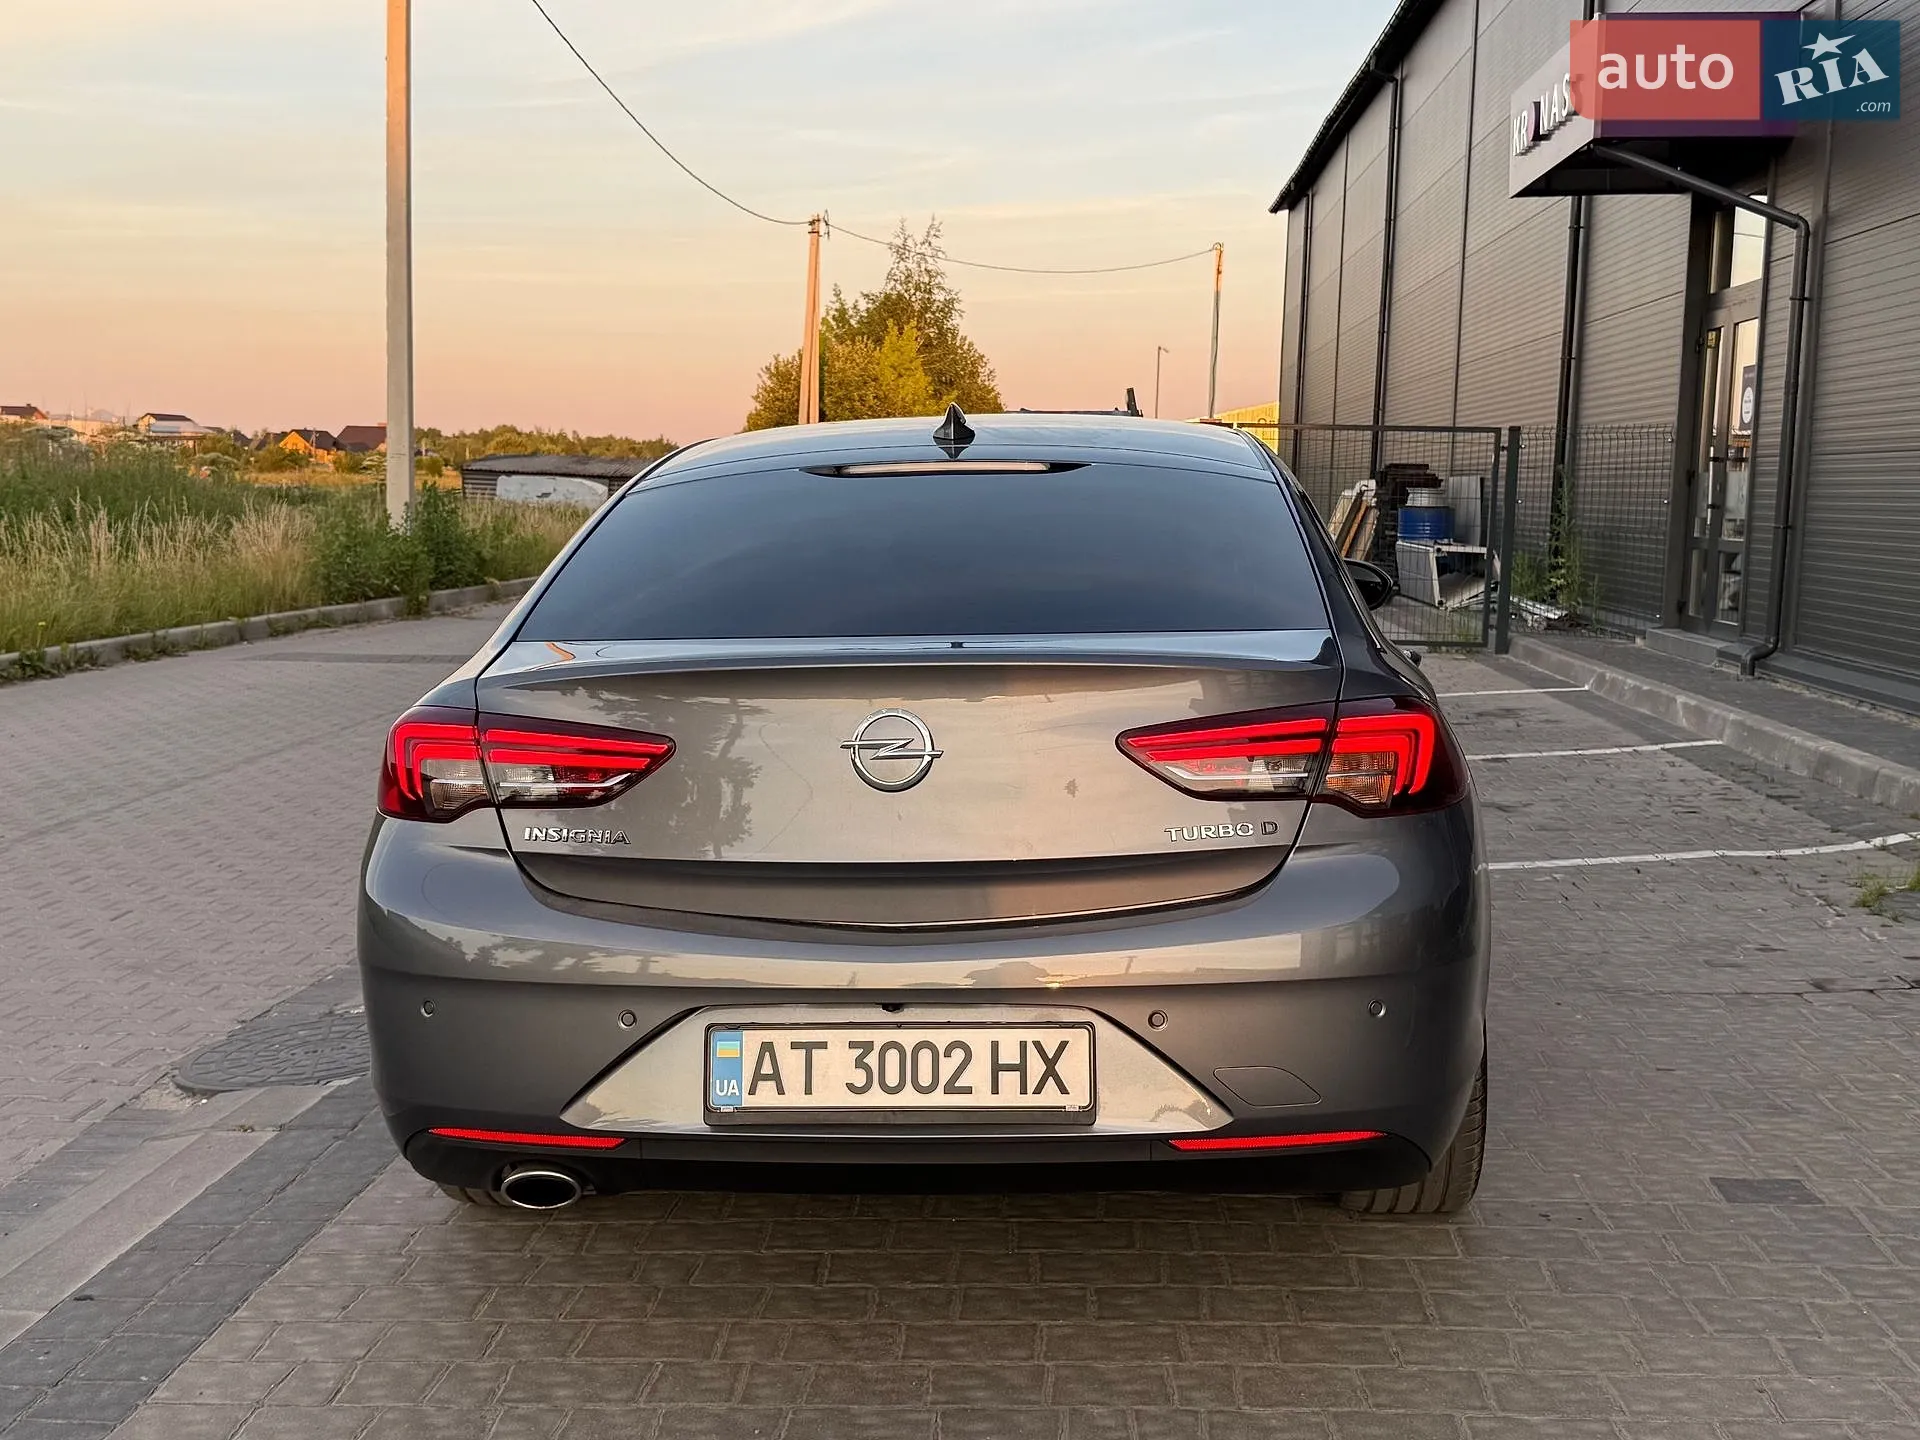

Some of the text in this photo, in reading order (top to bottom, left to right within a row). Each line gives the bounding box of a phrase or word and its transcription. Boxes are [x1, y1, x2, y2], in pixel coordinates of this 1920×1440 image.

[524, 827, 630, 844] INSIGNIA
[1164, 821, 1279, 842] TURBO D
[748, 1040, 1070, 1095] AT 3002 HX
[715, 1079, 740, 1096] UA
